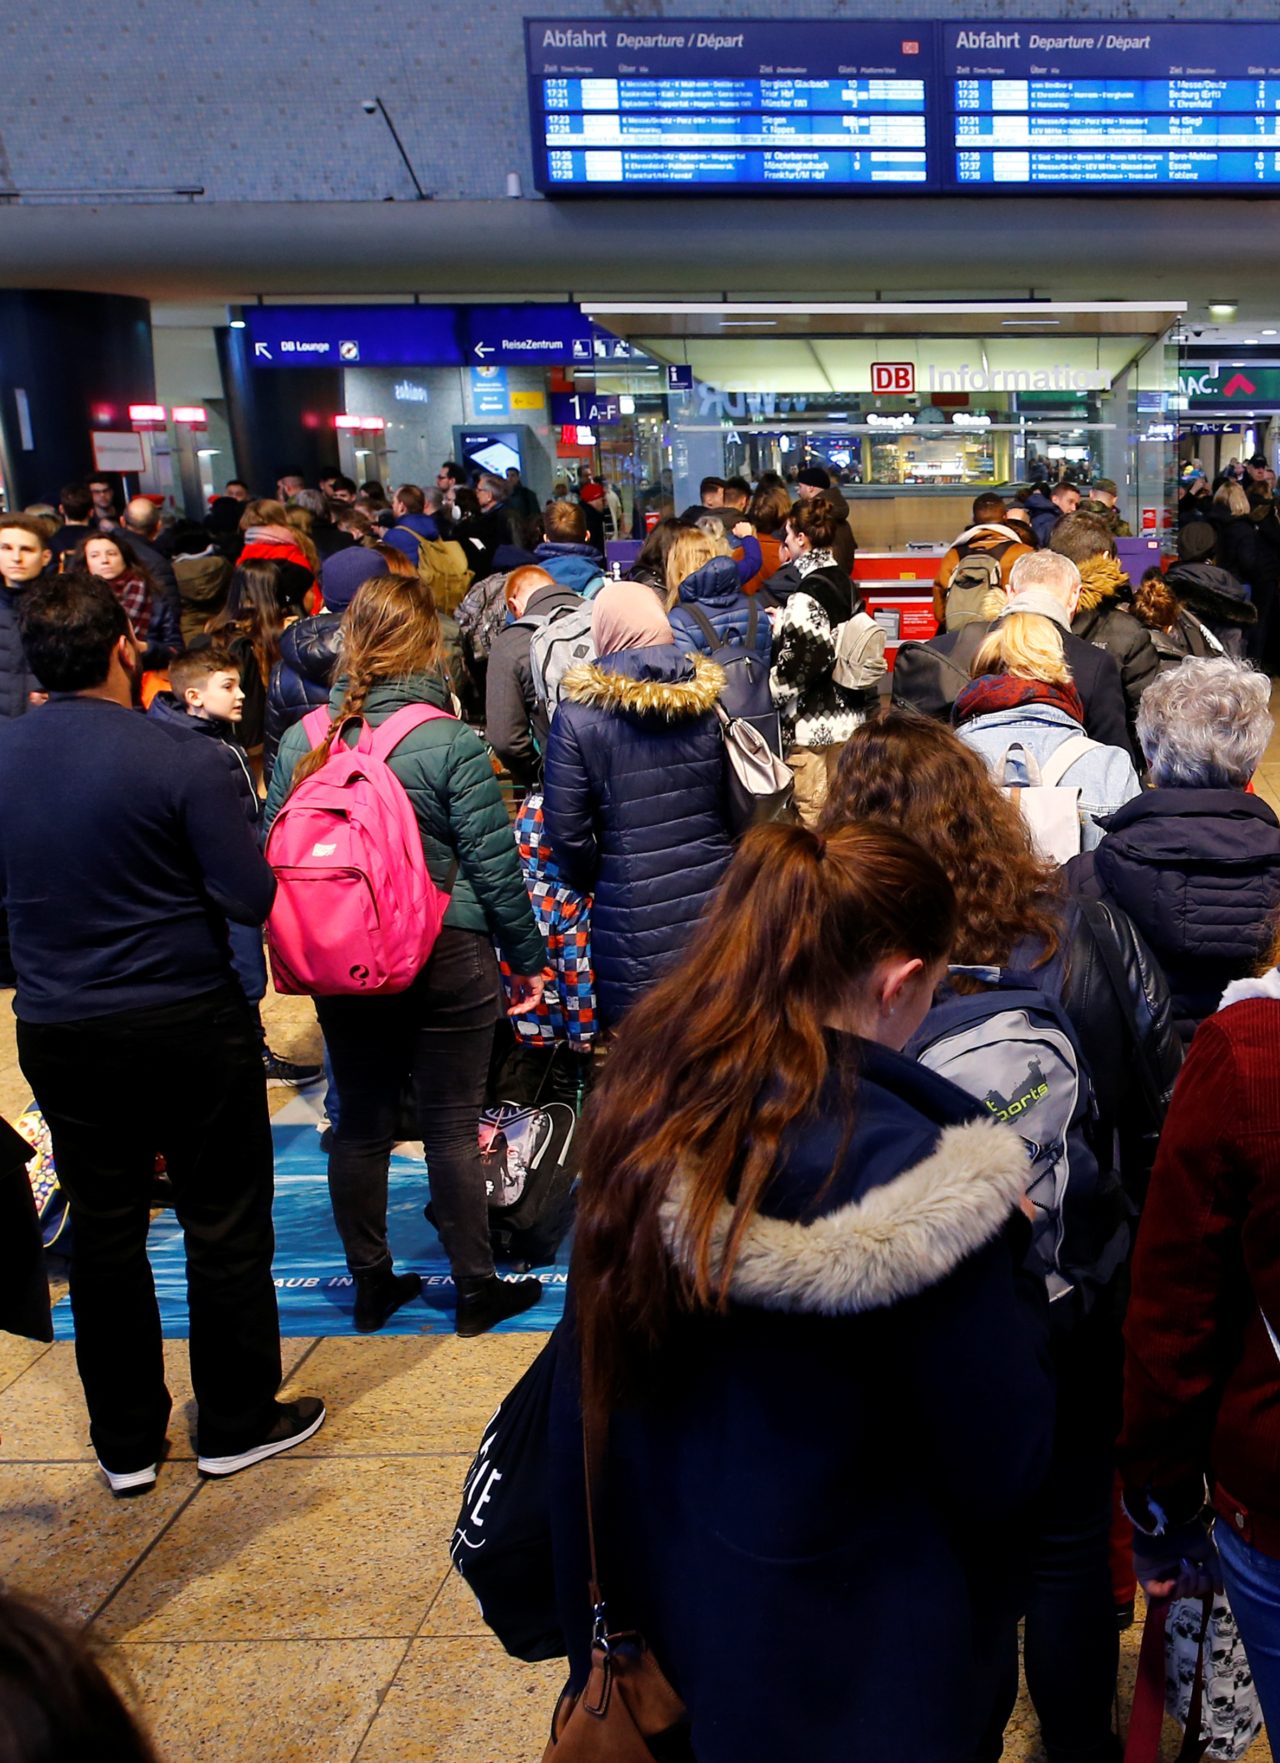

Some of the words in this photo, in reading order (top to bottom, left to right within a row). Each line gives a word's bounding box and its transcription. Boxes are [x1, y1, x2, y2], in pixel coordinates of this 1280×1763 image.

[543, 30, 607, 47] Abfahrt
[616, 33, 684, 50] Departure
[697, 33, 743, 50] Départ
[956, 32, 1020, 48] Abfahrt
[1029, 35, 1094, 51] Departure
[1106, 35, 1150, 51] Départ
[547, 79, 567, 87] 17:17
[280, 341, 295, 352] DB
[296, 341, 330, 353] Lounge
[502, 340, 563, 350] ReiseZentrum
[876, 367, 911, 390] DB
[929, 364, 1112, 392] Information
[569, 395, 581, 420] 1
[274, 1278, 320, 1288] AUB
